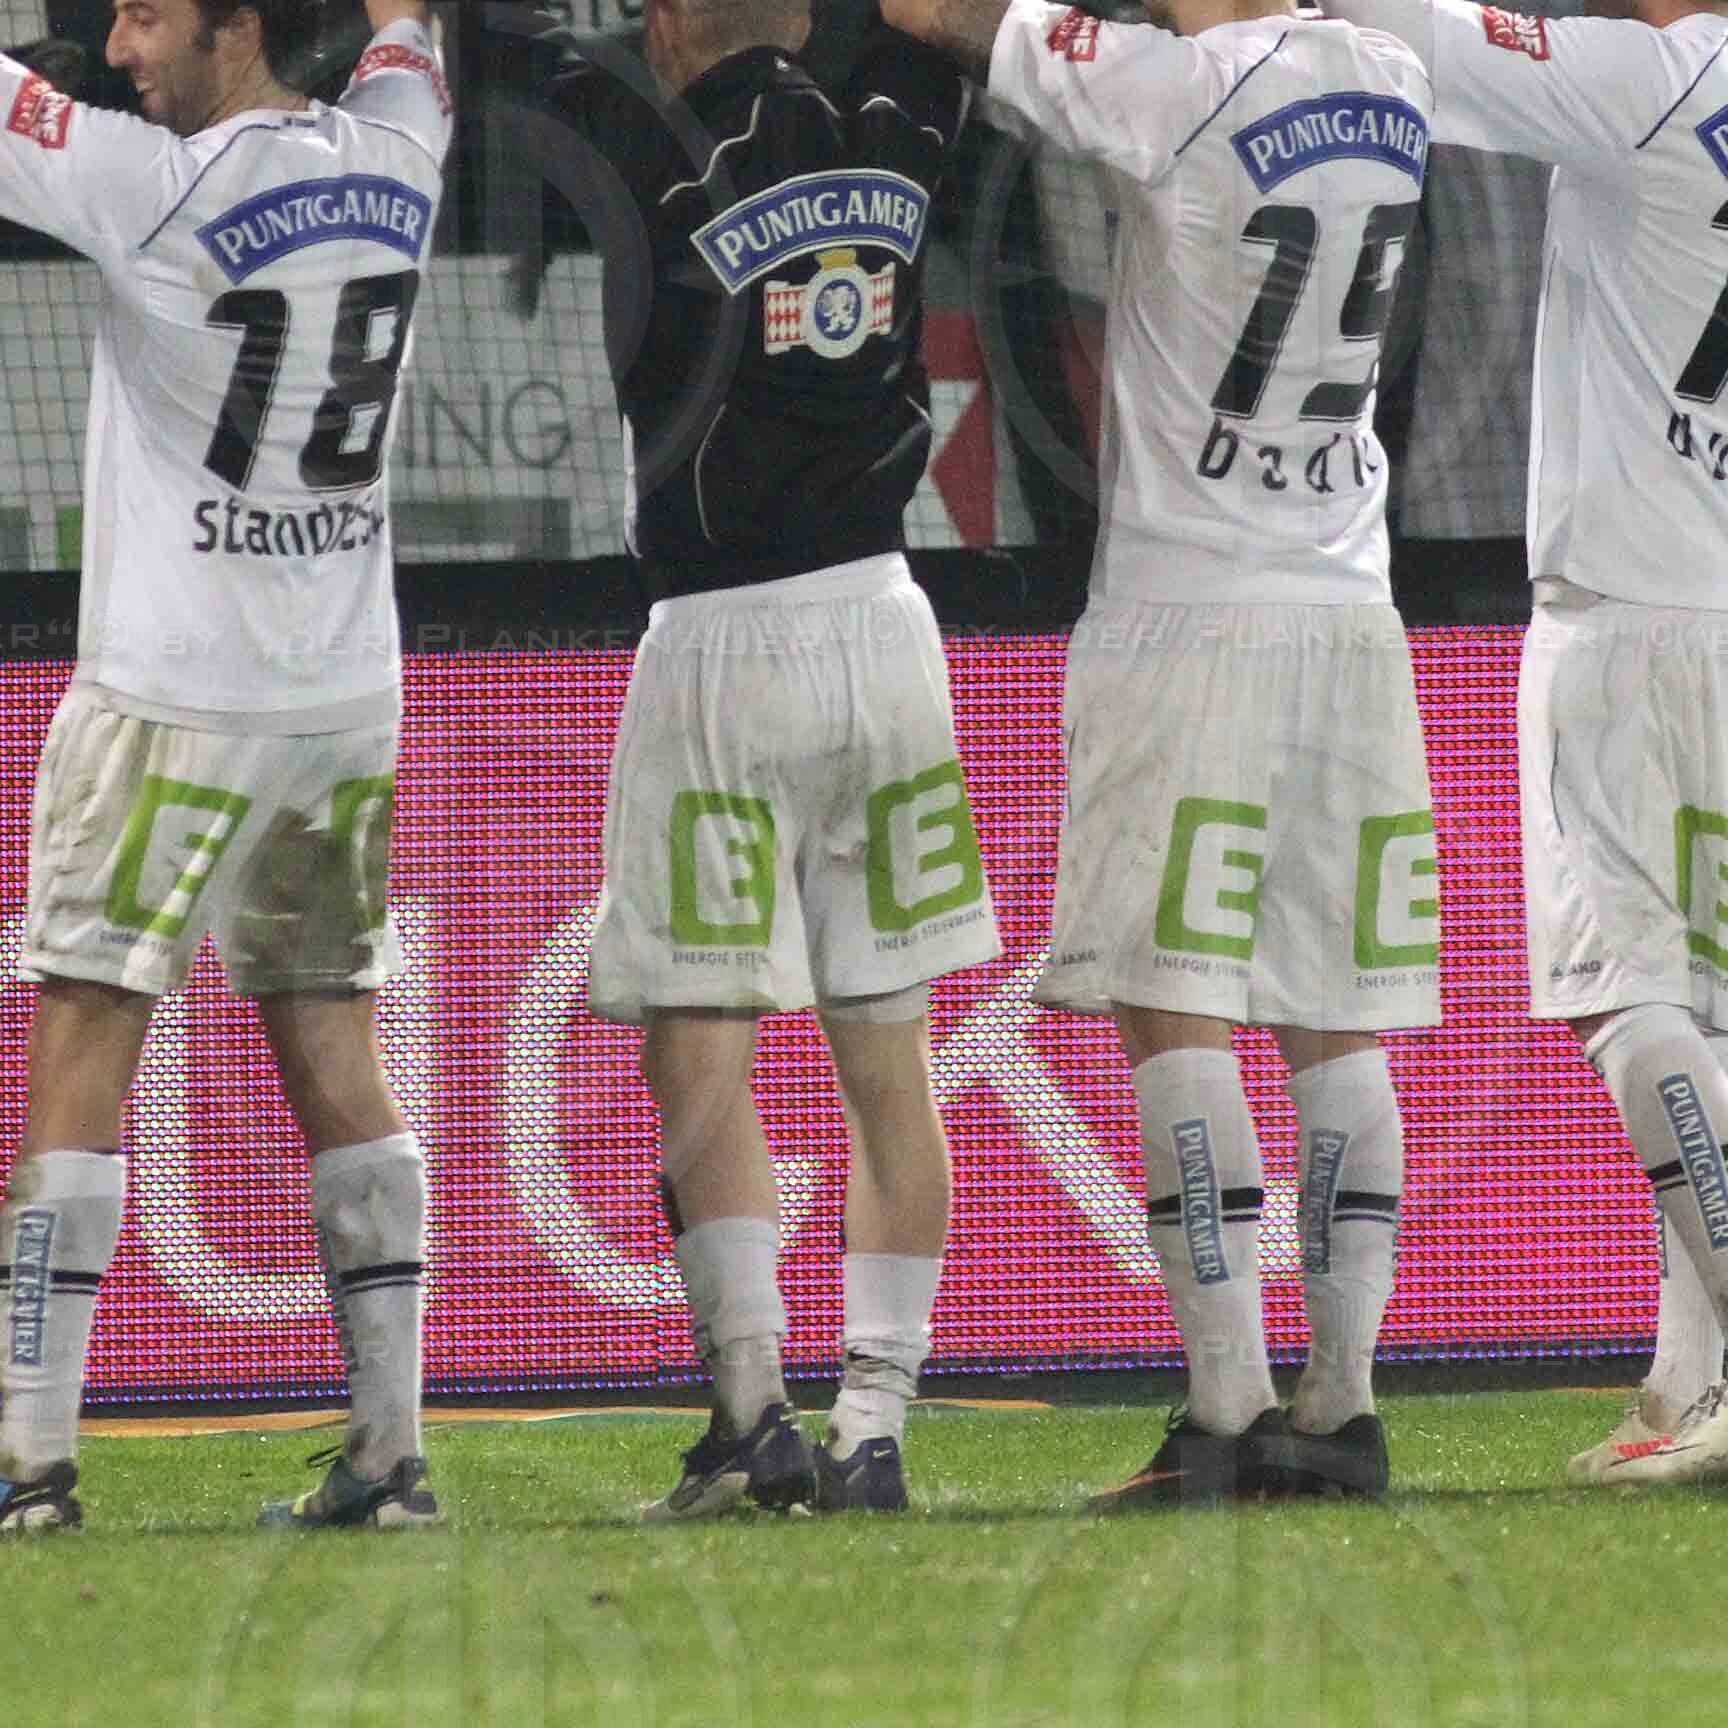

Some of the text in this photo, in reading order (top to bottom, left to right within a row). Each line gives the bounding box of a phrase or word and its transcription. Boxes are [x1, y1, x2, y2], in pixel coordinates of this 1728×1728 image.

[214, 189, 423, 265] PUNTIGAMER
[712, 189, 920, 270] PUNTIGAMER
[203, 269, 421, 493] 18
[1174, 1122, 1225, 1281] PUNTIGAMER
